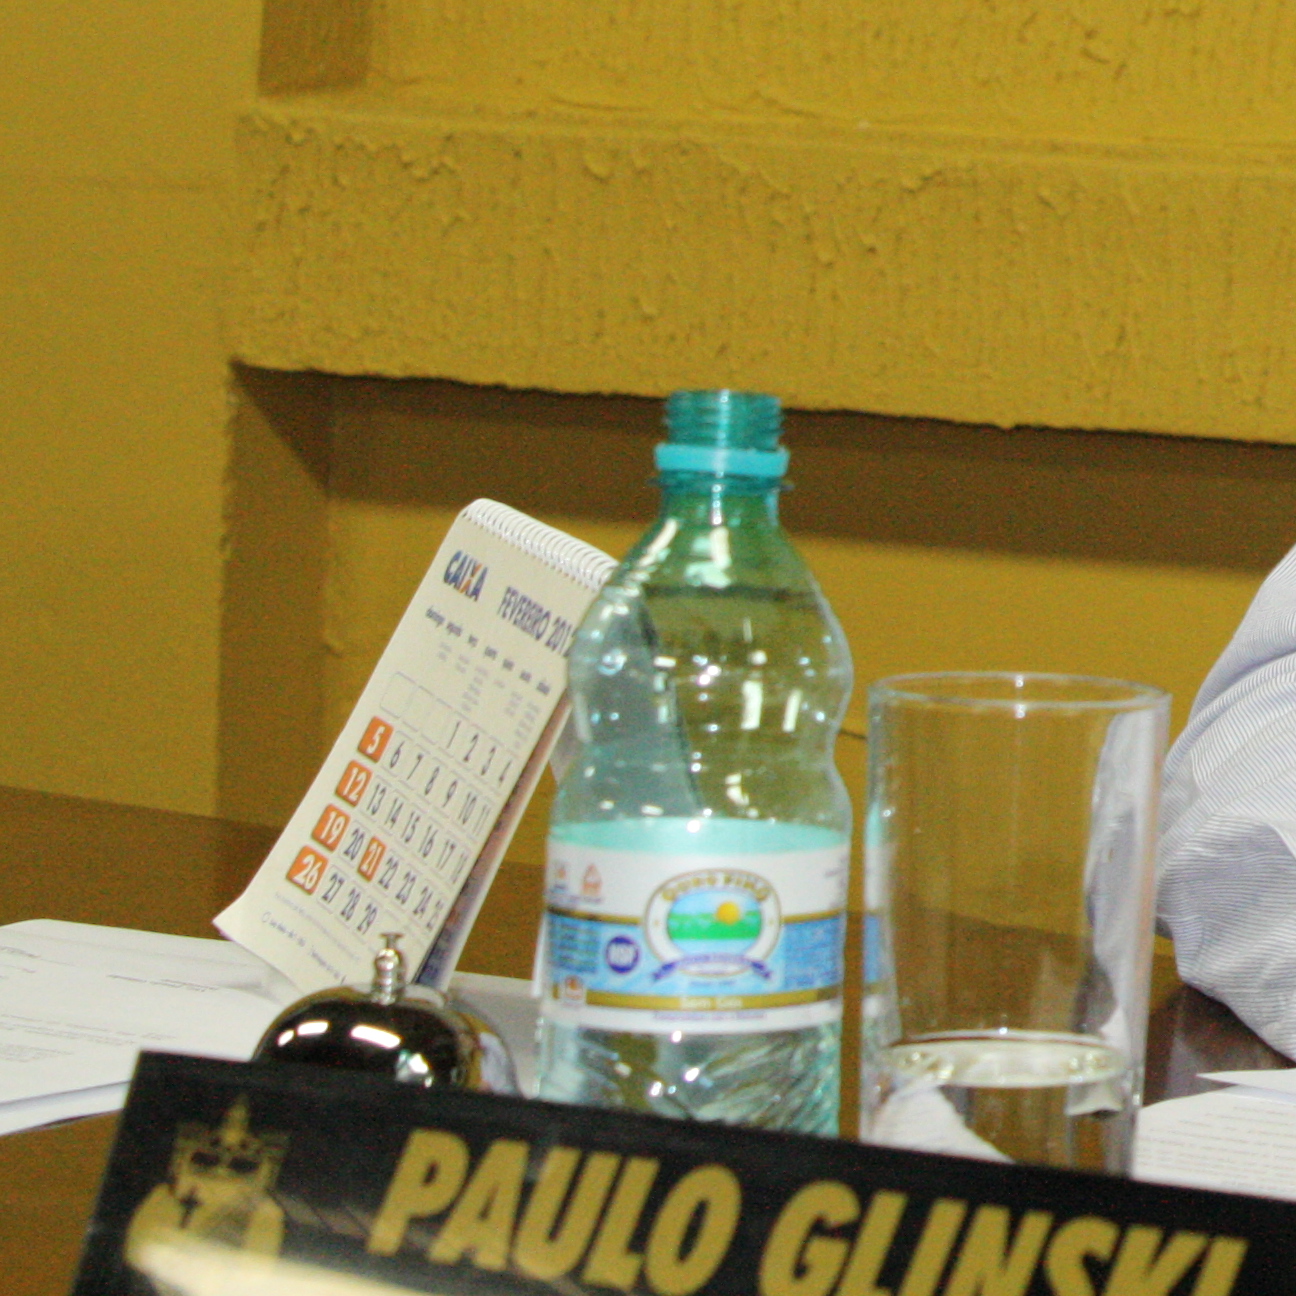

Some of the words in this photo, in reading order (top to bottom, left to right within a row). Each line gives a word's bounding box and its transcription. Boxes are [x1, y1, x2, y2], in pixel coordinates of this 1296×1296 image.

[443, 550, 488, 602] CAIXA
[497, 585, 551, 641] FEVEREIRO
[366, 725, 385, 754] 5
[390, 741, 405, 769] 6
[406, 753, 424, 780] 7
[424, 766, 440, 796] 8
[442, 780, 458, 808] 9
[458, 791, 476, 825] 10
[472, 804, 492, 836] 11
[446, 720, 461, 749] 1
[463, 733, 479, 762] 2
[481, 746, 496, 776] 3
[499, 759, 512, 787] 4
[320, 810, 346, 844] 19
[343, 826, 365, 861] 20
[361, 841, 382, 876] 21
[378, 855, 400, 890] 22
[395, 870, 417, 905] 23
[413, 886, 434, 919] 24
[343, 766, 367, 802] 12
[366, 783, 387, 816] 13
[384, 797, 404, 829] 14
[401, 810, 421, 843] 15
[418, 824, 439, 858] 16
[436, 839, 457, 871] 17
[292, 853, 322, 890] 26
[321, 871, 345, 904] 27
[340, 887, 361, 922] 28
[357, 903, 378, 935] 29
[365, 1128, 743, 1296] PAULO
[758, 1179, 1249, 1296] GLINSKI
